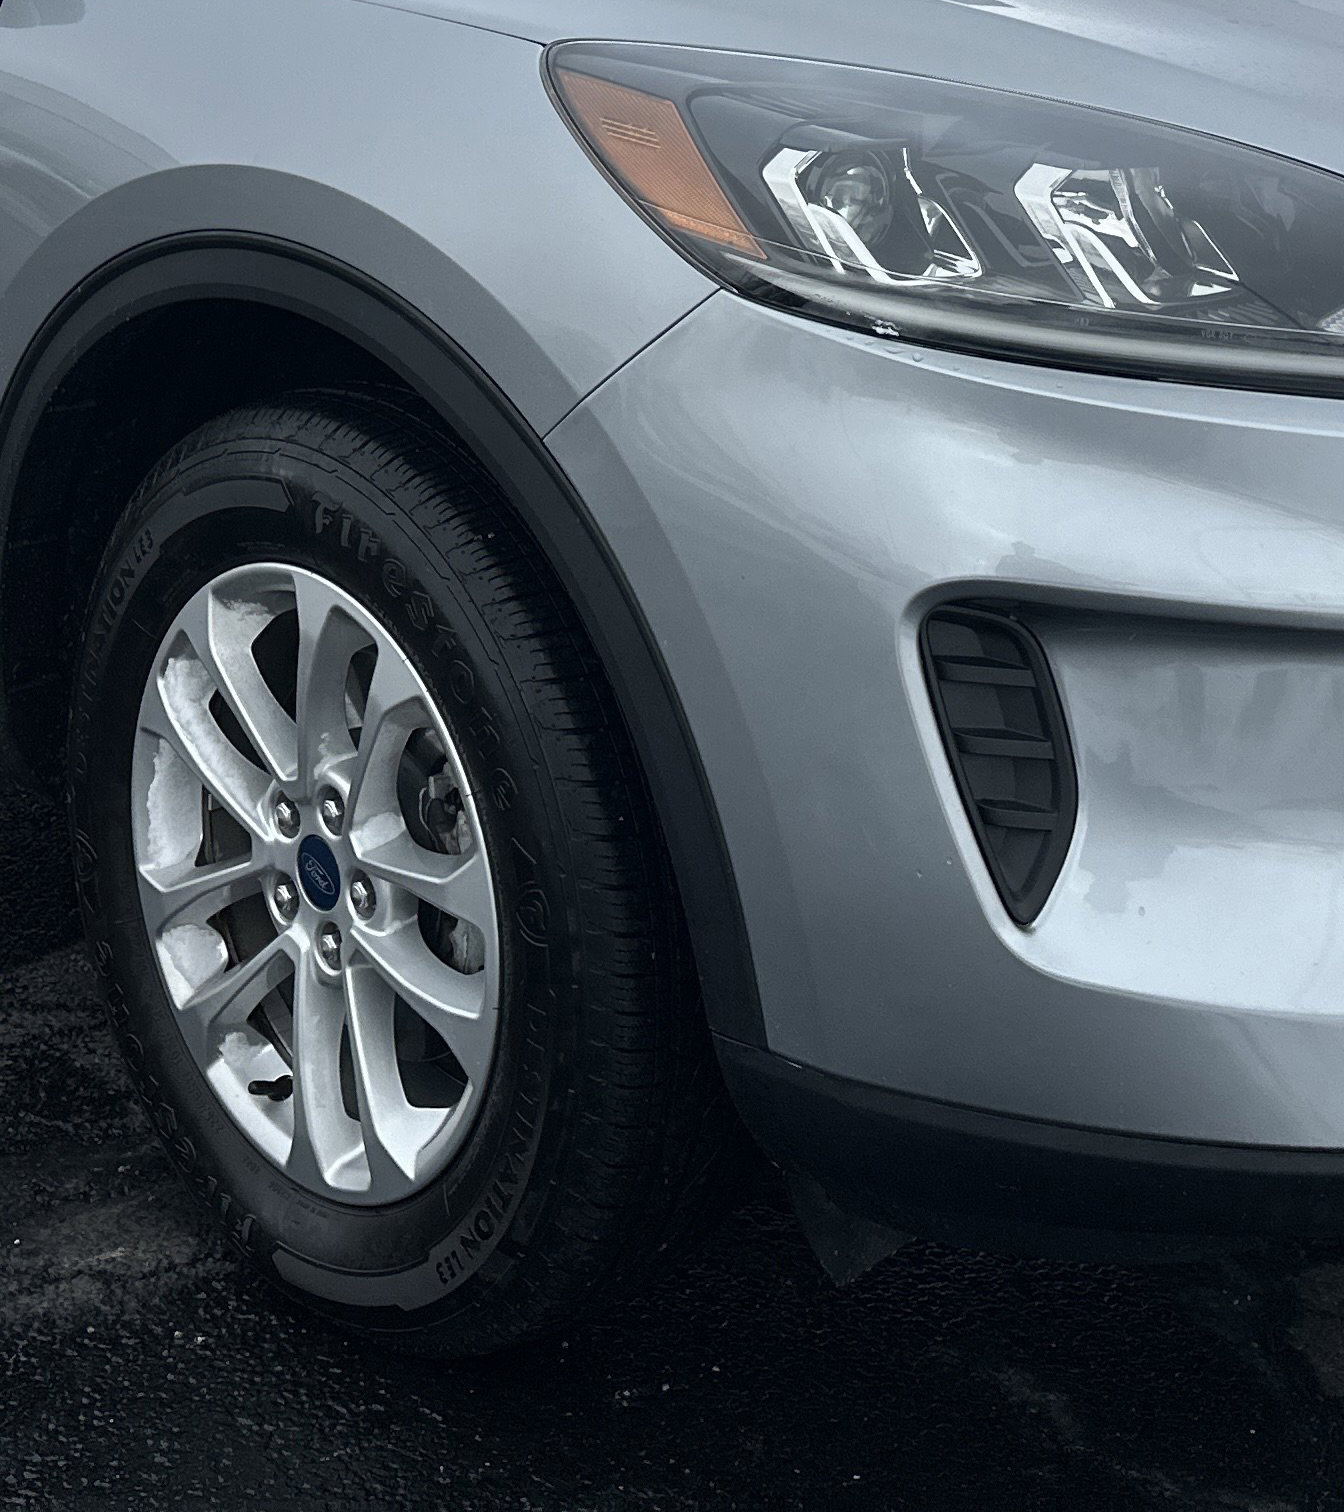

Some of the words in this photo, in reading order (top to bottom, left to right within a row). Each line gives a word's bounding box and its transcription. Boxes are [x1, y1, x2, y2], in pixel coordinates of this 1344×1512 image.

[312, 489, 519, 811] Firestone
[305, 859, 330, 889] Ford
[435, 1244, 465, 1285] LE3
